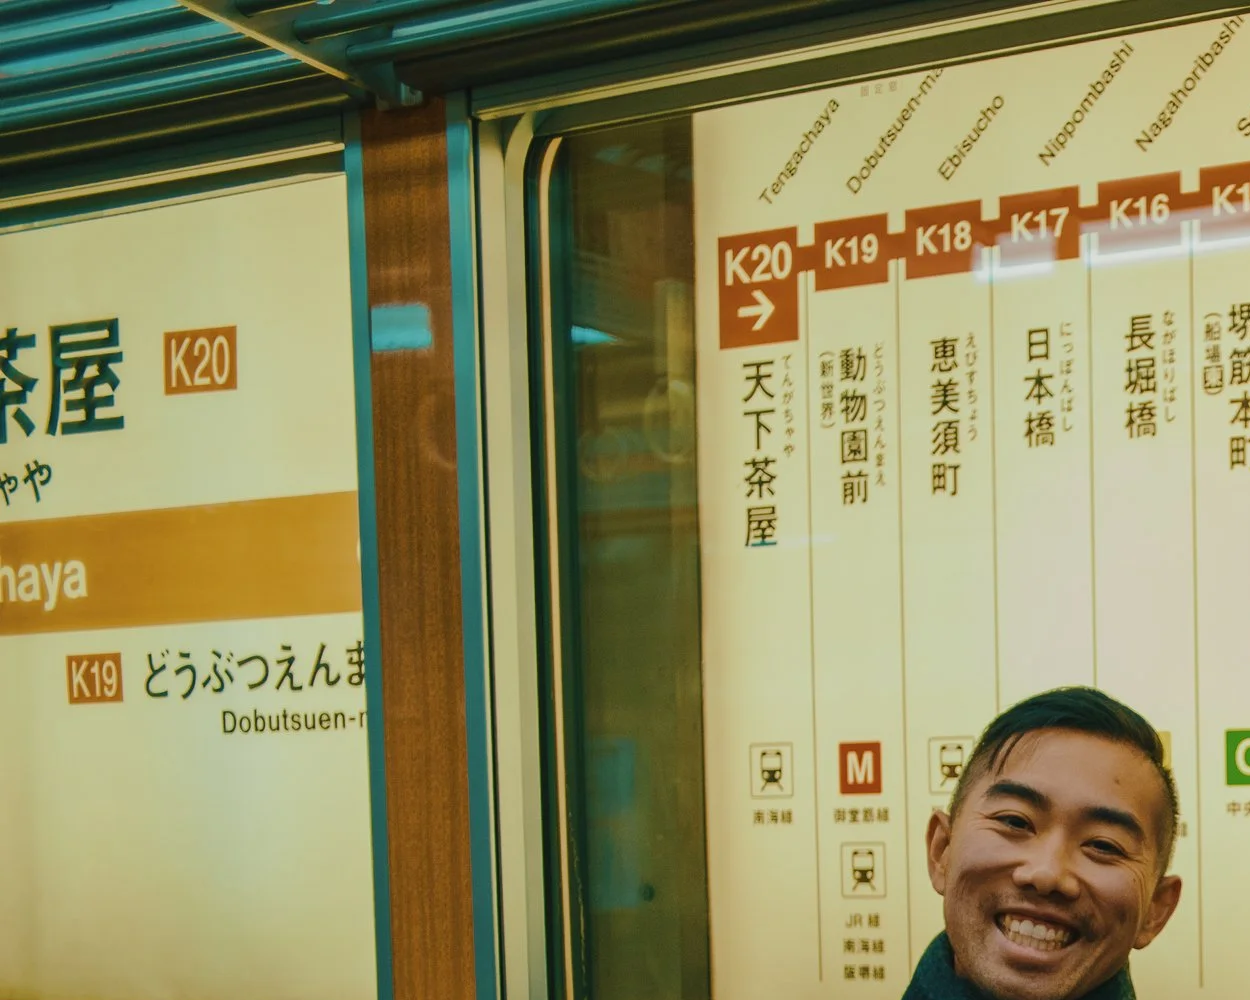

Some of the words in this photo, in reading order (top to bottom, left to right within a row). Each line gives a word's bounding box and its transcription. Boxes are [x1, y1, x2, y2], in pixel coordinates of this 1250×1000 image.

[1037, 40, 1135, 167] Nippombashi
[1134, 15, 1245, 153] Nagahoribashi
[759, 98, 840, 205] Tengachaya
[937, 94, 1005, 181] Ebisucho
[916, 220, 972, 256] K18
[1010, 206, 1070, 243] K17
[1109, 193, 1170, 231] K16
[724, 240, 792, 286] K20
[824, 233, 879, 269] K19
[171, 335, 229, 387] K20
[1024, 327, 1055, 448] 日本橋
[1124, 314, 1157, 439] 長堀橋
[840, 346, 869, 506] 動物園前
[930, 336, 961, 496] 恵美須町
[742, 359, 778, 547] 天下茶屋
[71, 659, 118, 698] K19
[144, 640, 365, 699] どうぶつえんま
[847, 750, 874, 785] M
